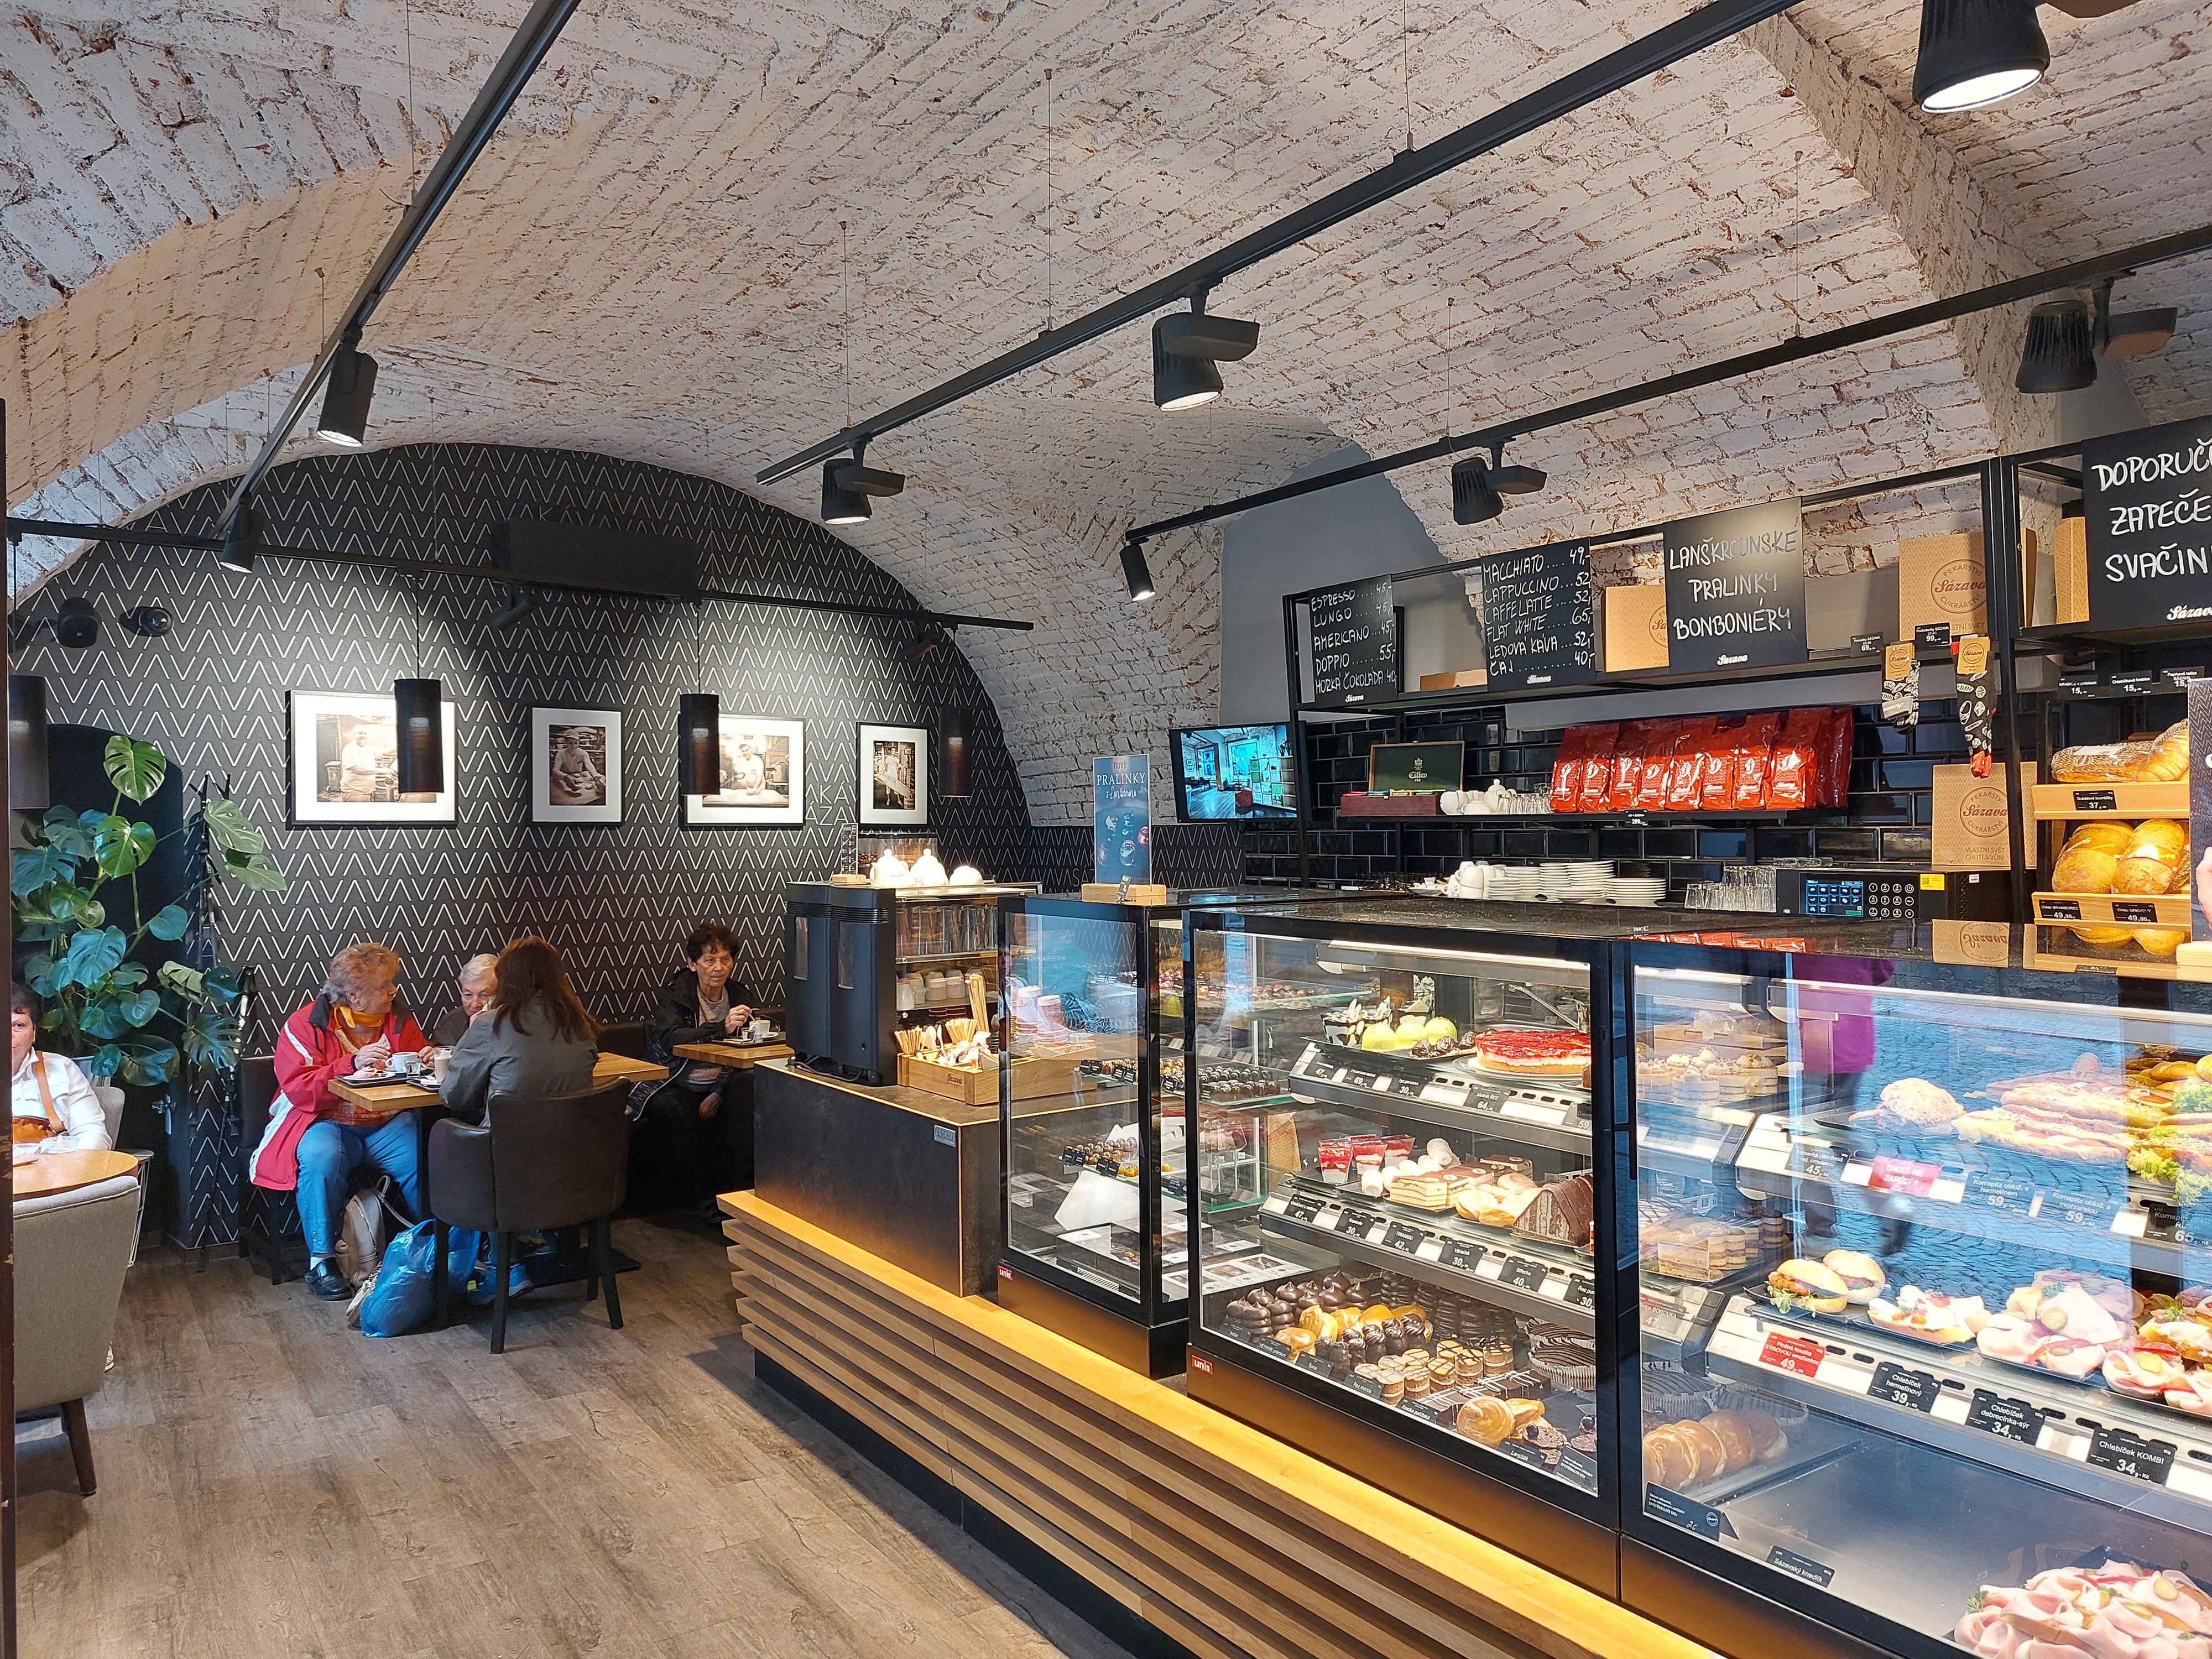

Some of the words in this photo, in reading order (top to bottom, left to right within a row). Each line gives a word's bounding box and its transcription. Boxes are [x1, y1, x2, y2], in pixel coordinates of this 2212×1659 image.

[2091, 437, 2212, 492] DOPORUČ
[1670, 516, 1799, 570] LANŠKROUNSKÉ
[1483, 554, 1545, 586] MACCHIATO
[1942, 562, 1984, 578] PEKAŘSTVÍ
[2105, 542, 2212, 582] SVAČIN
[1484, 576, 1559, 604] CAPPUCCINO
[1688, 571, 1778, 603] PRALINKY
[1934, 578, 1986, 594] Sázava
[1311, 589, 1355, 612] ESPRESSO
[1939, 593, 1983, 608] CUKRÁŘSTVÍ
[1313, 608, 1352, 628] LUNGO
[1672, 597, 1792, 640] BONBONIÉRY
[2167, 604, 2212, 620] Sázav
[1486, 622, 1511, 643] FLAT
[1515, 614, 1548, 635] WHITE
[1951, 622, 1967, 631] STNÍ
[1314, 625, 1370, 651] AMERICANO
[1489, 635, 1527, 659] LEDOVÁ
[1531, 633, 1558, 654] KÁVA
[1316, 653, 1350, 676] DOPPIO
[1489, 660, 1514, 677] ČAJ
[1316, 671, 1342, 695] HORKÁ
[1343, 666, 1384, 690] ČOKOLÁDA
[1113, 759, 1127, 770] nové
[1097, 773, 1145, 786] PRALINKY
[1969, 790, 2006, 805] PEKAŘSTVÍ
[1963, 804, 2008, 817] Sázava
[1967, 819, 2004, 833] CUKRÁŘSTVÍ
[1765, 1343, 1792, 1357] SÝROVOU
[1193, 1357, 1211, 1373] unis
[1886, 1379, 1923, 1397] hermelínový
[1891, 1374, 1922, 1389] Chlebíček
[1980, 1409, 2030, 1430] debrecínka-sýr
[1991, 1404, 2024, 1420] Chlebíček
[2099, 1439, 2136, 1457] Chlebíček
[2136, 1451, 2165, 1465] KOMBI
[1773, 1557, 1802, 1575] Sázavský
[1801, 1569, 1823, 1583] knedlík
